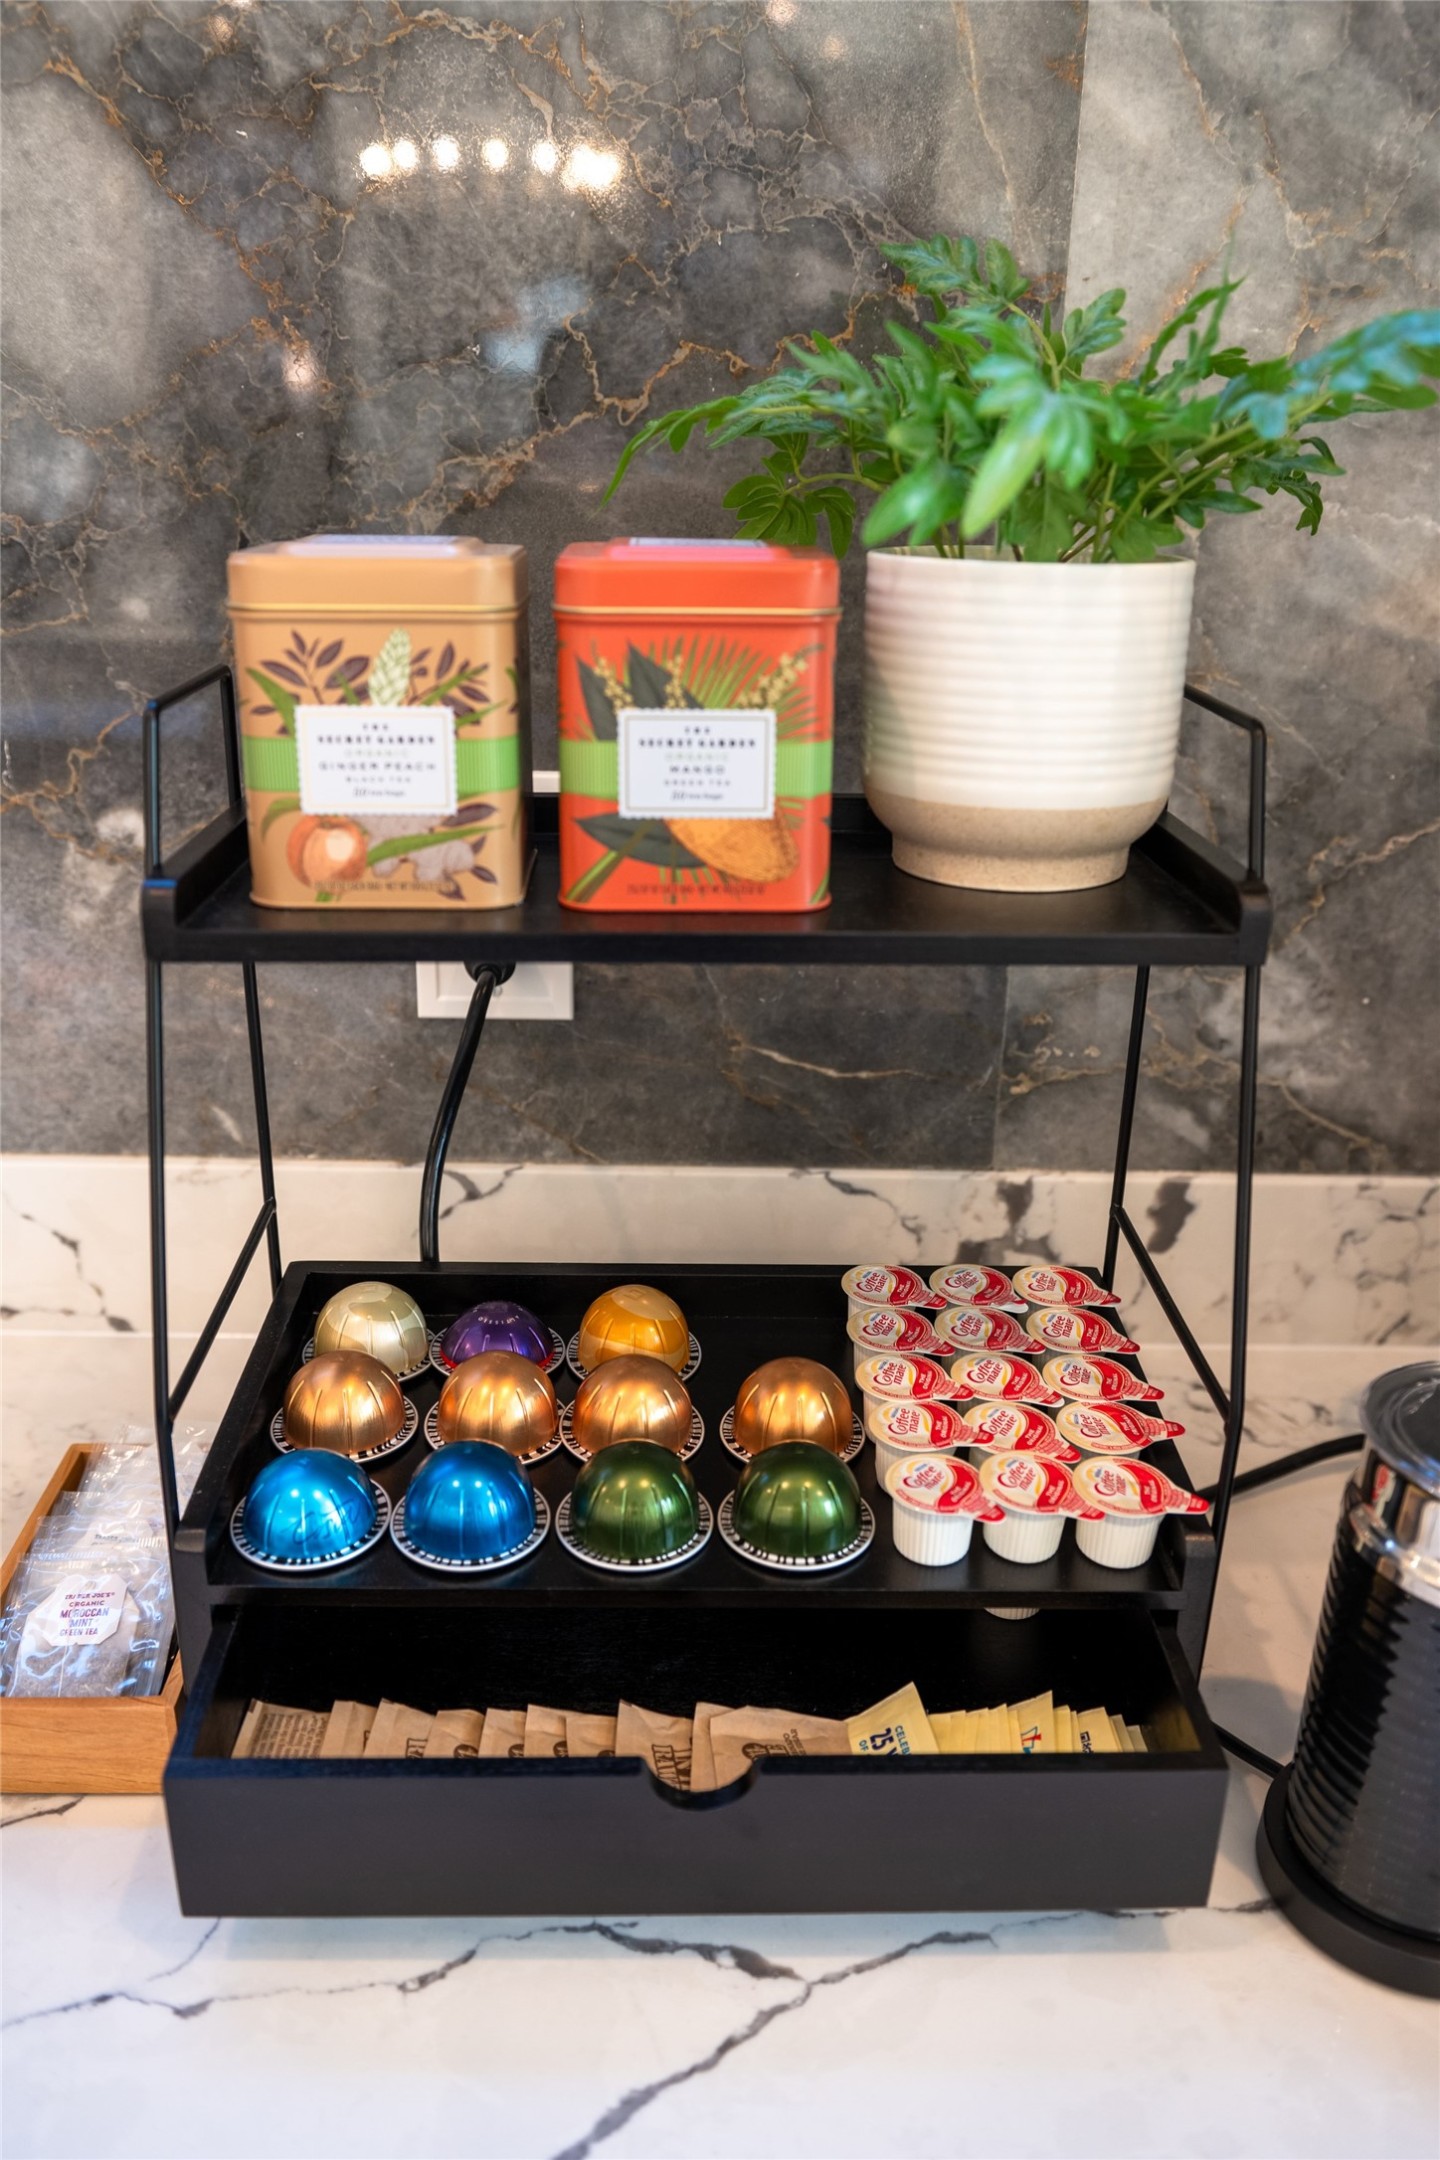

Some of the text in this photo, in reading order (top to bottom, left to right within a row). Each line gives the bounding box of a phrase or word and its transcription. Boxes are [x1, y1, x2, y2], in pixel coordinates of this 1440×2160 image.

[362, 722, 389, 731] THE
[683, 726, 711, 735] THE
[318, 735, 435, 744] SECRET GARDEN
[639, 738, 756, 748] SECRET GARDEN
[345, 748, 409, 758] ORGANIC
[664, 752, 728, 762] ORGANIC
[319, 761, 436, 771] GINGER PEACH
[669, 765, 725, 775] MANGO
[856, 1272, 880, 1292] Coffee
[874, 1275, 888, 1293] mate
[1028, 1273, 1048, 1291] Coffee
[1046, 1276, 1057, 1291] mate
[863, 1314, 889, 1336] Coffee
[881, 1318, 897, 1336] mate
[1043, 1315, 1065, 1338] Coffee
[1062, 1317, 1075, 1337] mate
[873, 1362, 897, 1386] Coffee
[894, 1363, 906, 1385] mate
[967, 1359, 995, 1383] Coffee
[986, 1363, 1003, 1384] mate
[888, 1408, 910, 1435] Coffee
[909, 1410, 921, 1433] mate
[979, 1410, 1009, 1435] Coffee
[999, 1415, 1017, 1436] mate
[1080, 1413, 1102, 1438] Coffee
[1091, 1415, 1111, 1435] mate
[903, 1466, 936, 1488] Coffee
[924, 1472, 944, 1490] mate
[997, 1461, 1028, 1488] Coffee
[1019, 1468, 1036, 1490] mate
[69, 1619, 93, 1628] MINT
[84, 1628, 98, 1636] TEA
[858, 1739, 869, 1752] OF
[869, 1727, 895, 1750] 25
